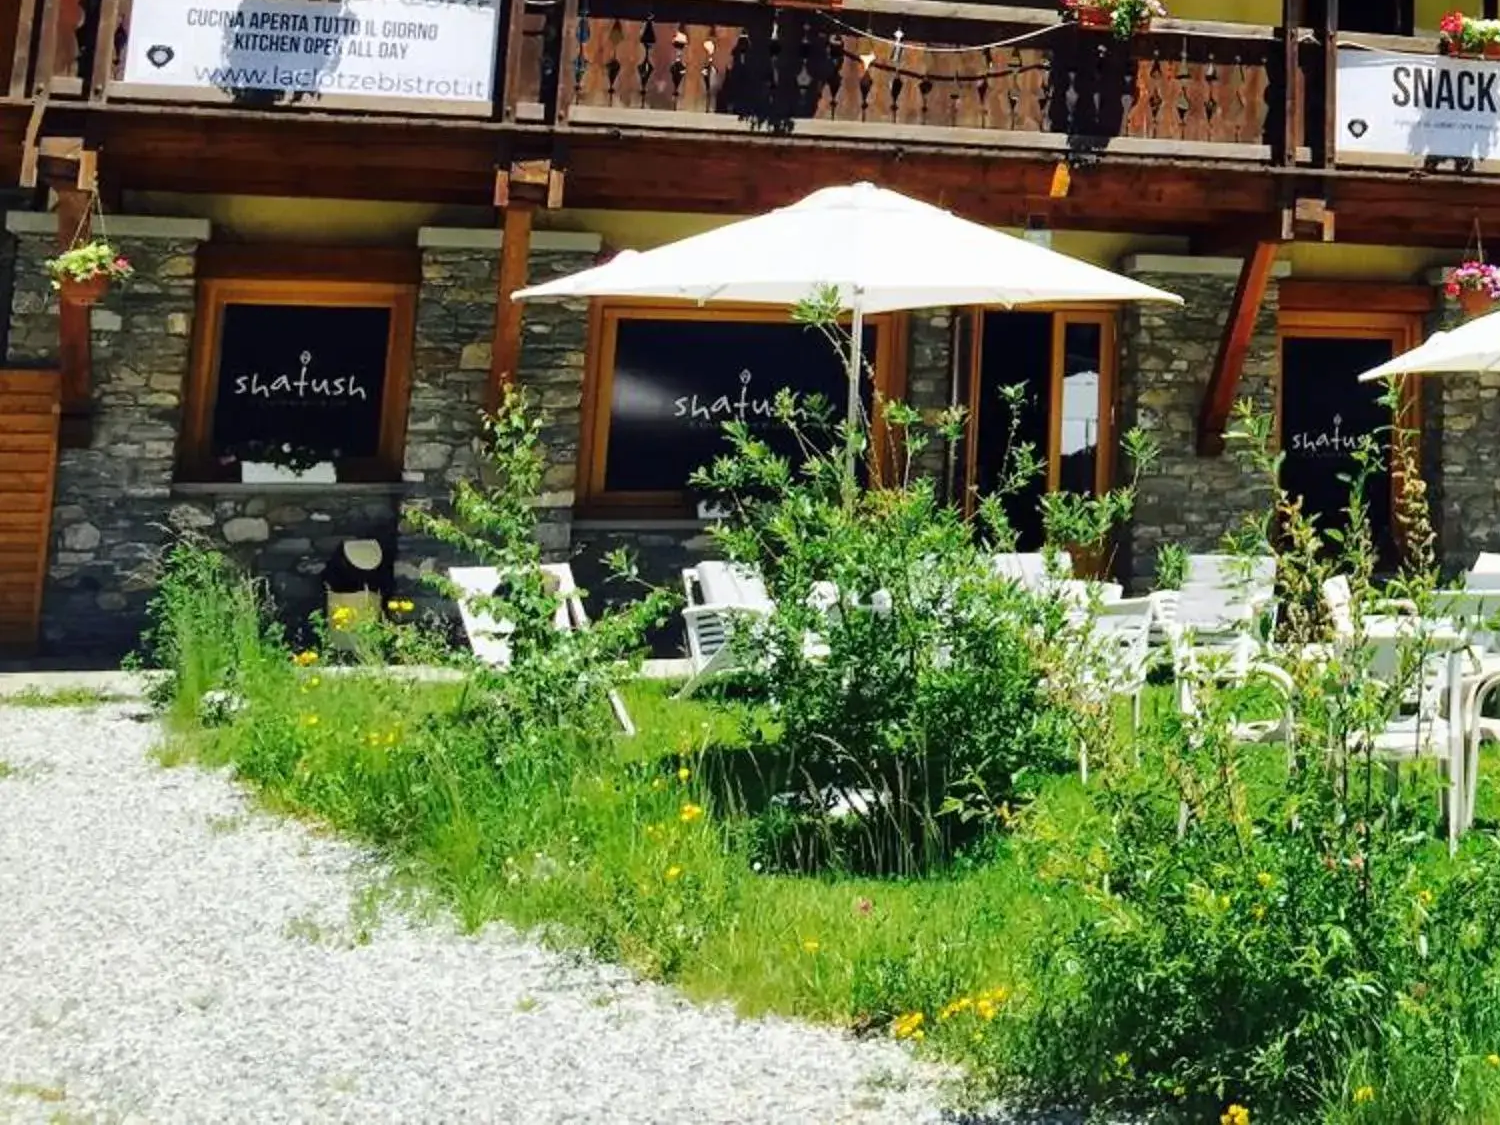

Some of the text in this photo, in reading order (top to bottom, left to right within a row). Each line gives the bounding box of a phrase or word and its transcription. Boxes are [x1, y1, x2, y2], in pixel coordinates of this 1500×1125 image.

[187, 7, 439, 41] CUCINA APERTA TUTTO IL GIORNO
[234, 32, 409, 60] KITCHEN OPEN ALL DAY
[1391, 65, 1498, 113] SNACK
[234, 366, 368, 400] shatush
